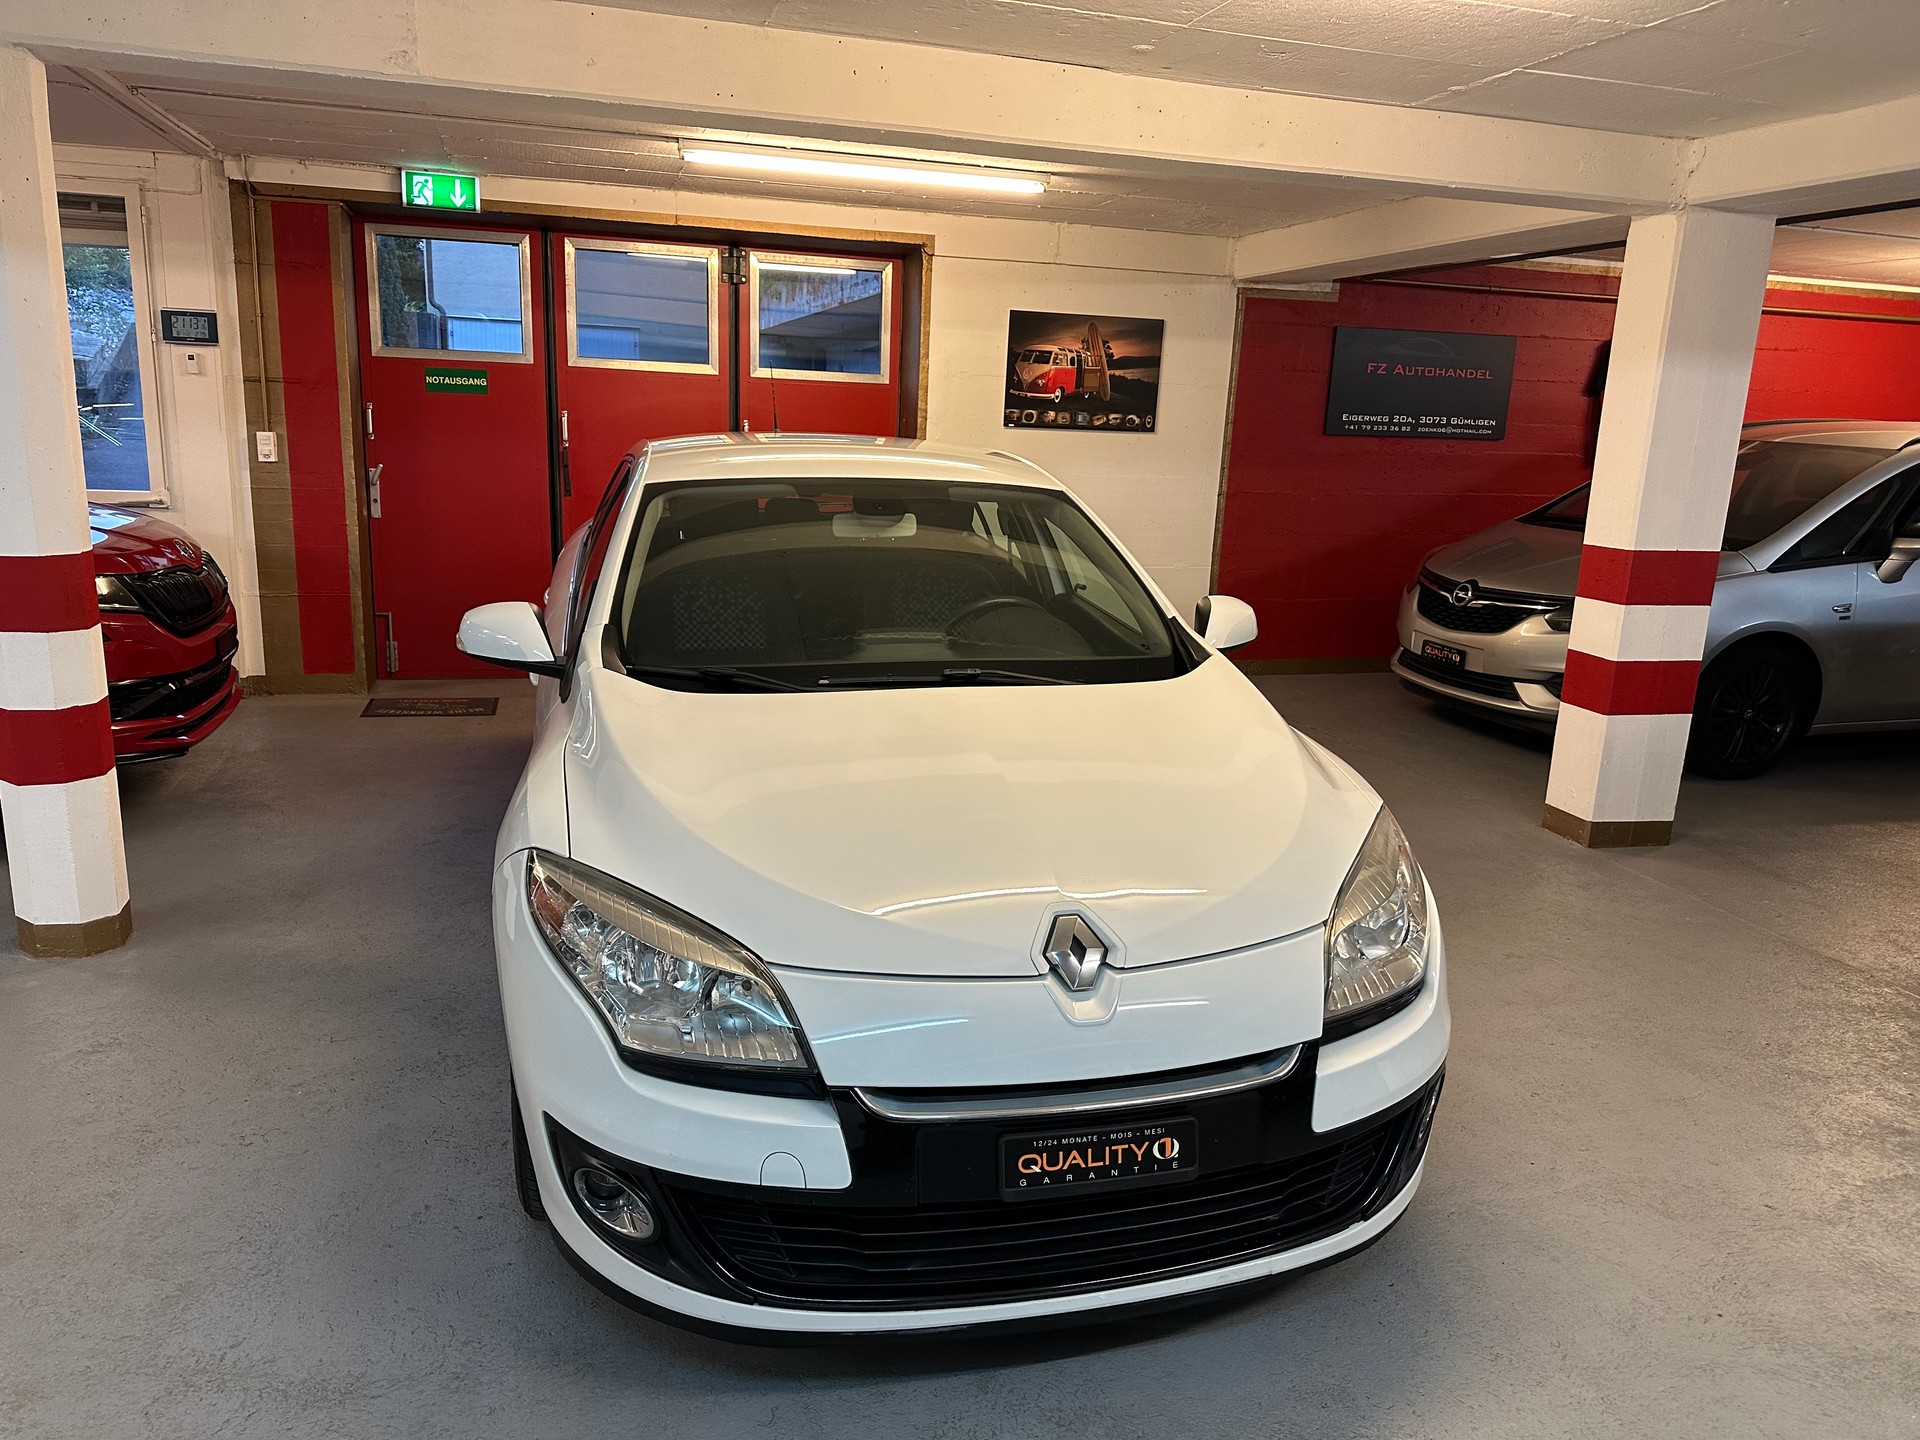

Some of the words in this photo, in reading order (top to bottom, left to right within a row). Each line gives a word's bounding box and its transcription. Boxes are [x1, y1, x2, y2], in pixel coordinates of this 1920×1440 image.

[1367, 362, 1387, 375] FZ
[425, 376, 487, 386] NOTAUSGANG
[1419, 416, 1447, 424] 3073
[1425, 646, 1453, 658] QUALITY
[1033, 1139, 1058, 1147] 12/24
[1061, 1135, 1098, 1145] MONATE
[1110, 1131, 1133, 1140] MOIS
[1144, 1127, 1166, 1136] MESI
[1017, 1141, 1150, 1174] QUALITY
[1019, 1161, 1179, 1187] GARANTIE
